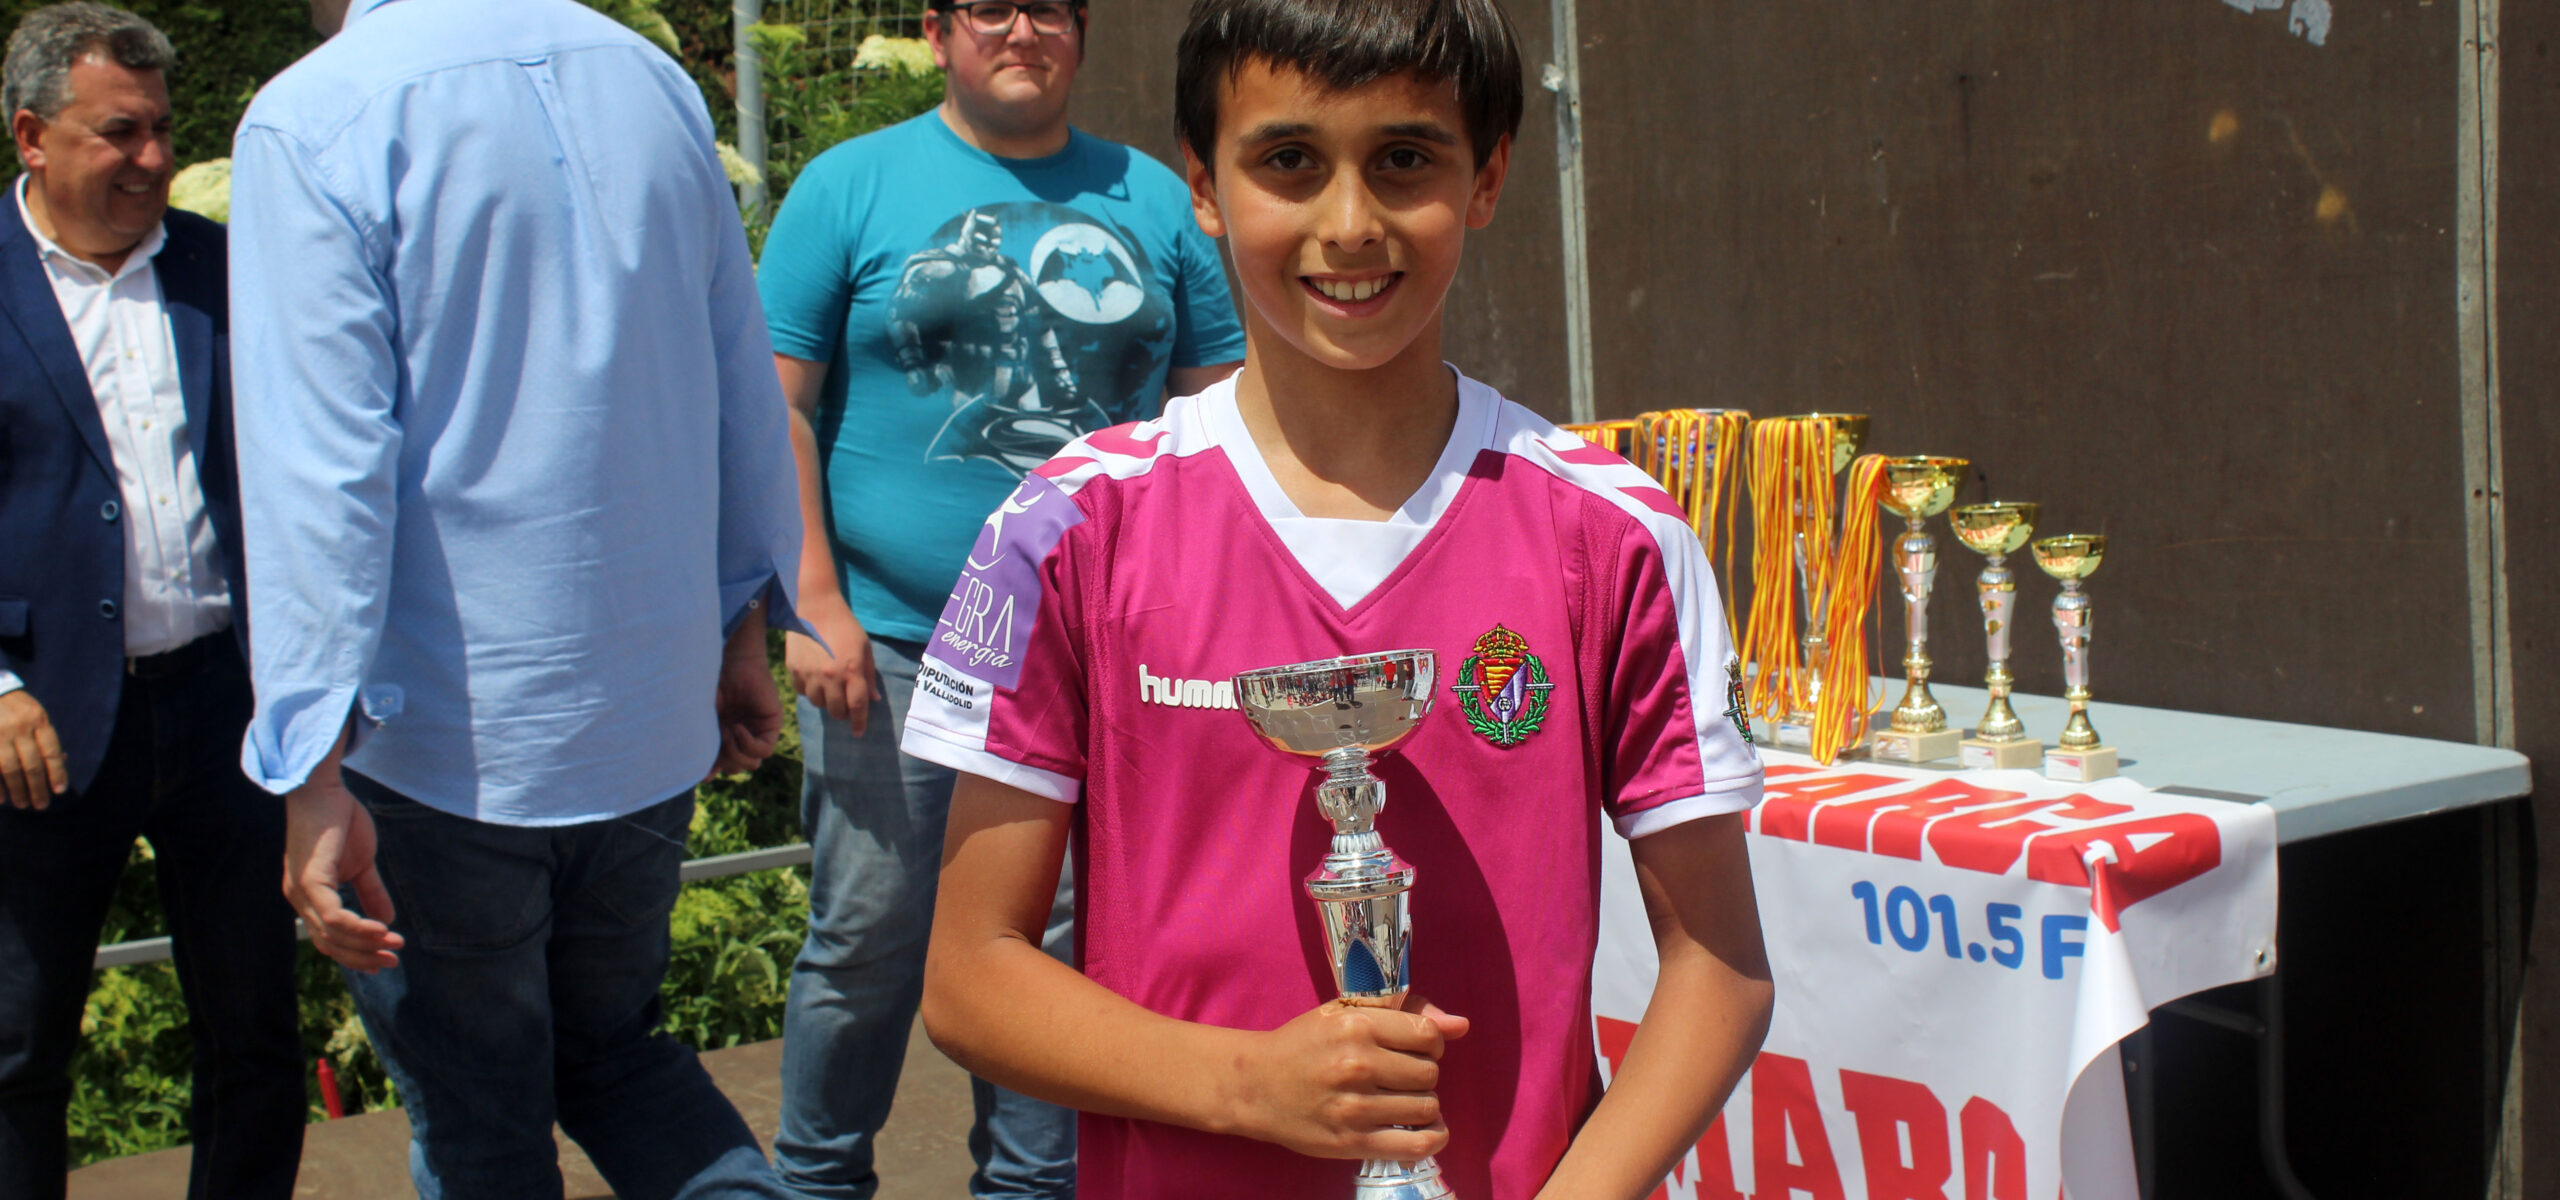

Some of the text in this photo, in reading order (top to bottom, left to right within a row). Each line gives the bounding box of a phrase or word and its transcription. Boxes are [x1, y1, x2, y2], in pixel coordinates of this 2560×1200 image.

[941, 631, 1013, 668] energía
[1741, 764, 2222, 933] ARCA
[1851, 880, 2025, 970] 101.5
[1596, 1015, 2064, 1200] ARC
